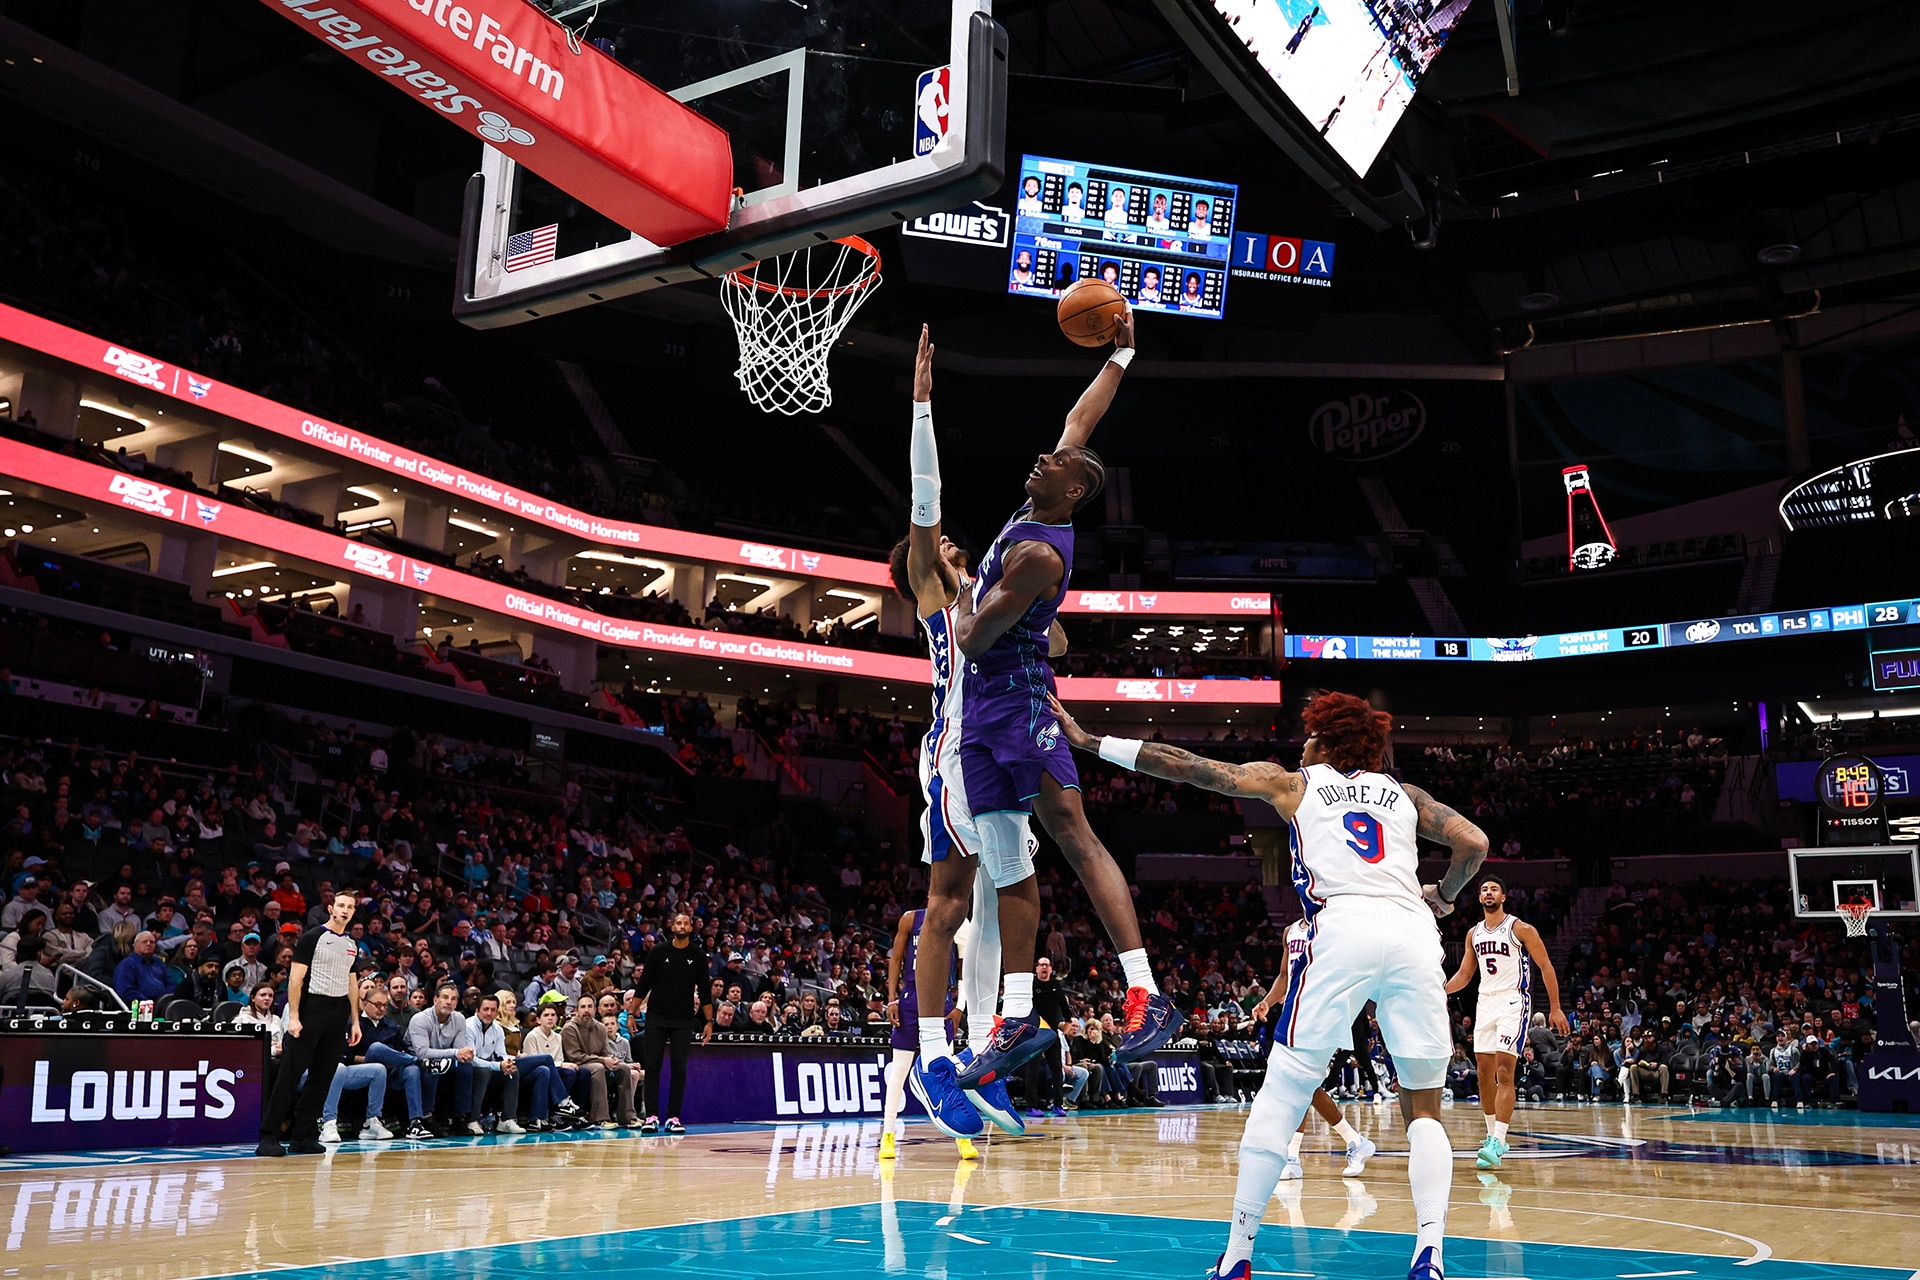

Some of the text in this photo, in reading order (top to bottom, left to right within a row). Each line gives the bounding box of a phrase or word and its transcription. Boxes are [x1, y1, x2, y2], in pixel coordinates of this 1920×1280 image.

[919, 135, 937, 153] NBA
[74, 150, 101, 171] 210
[914, 212, 999, 241] LOWE'S
[1231, 269, 1332, 288] INSURANCE OFFICE OF AMERICA
[103, 346, 165, 381] DEX
[1350, 393, 1390, 425] Dr
[1321, 400, 1418, 454] Pepper
[108, 474, 174, 507] DEX
[301, 420, 641, 543] Official Printer and Copier Provider for your Charlotte Hornets
[343, 543, 394, 570] DEX
[739, 543, 784, 564] DEX
[1260, 558, 1288, 569] HIVE
[1230, 596, 1271, 610] Official
[1733, 623, 1760, 634] TOL
[1762, 619, 1774, 632] 6
[1783, 617, 1807, 630] FLS
[1812, 614, 1823, 627] 2
[1832, 610, 1864, 626] PHI
[1875, 606, 1899, 622] 28
[505, 593, 854, 668] Official Printer and Copier Provider for your Charlotte Hornets
[1559, 631, 1608, 645] POINTS IN
[1631, 631, 1650, 645] 20
[1373, 637, 1420, 648] POINTS IN
[1443, 643, 1458, 656] 18
[1559, 642, 1610, 655] THE PAINT
[1371, 648, 1421, 659] THE PAINT
[1881, 660, 1920, 680] FLI
[1836, 766, 1869, 782] 8:49
[1373, 787, 1399, 812] JR.
[1844, 782, 1869, 807] 16
[1841, 817, 1879, 826] TISSOT
[1342, 810, 1386, 864] 9
[1474, 941, 1510, 958] PHILA
[1485, 957, 1498, 975] 5
[9, 1019, 262, 1032] G G G G G G G G G G G G
[1500, 1034, 1512, 1046] 76
[1157, 1063, 1197, 1092] OWE'S
[30, 1060, 236, 1123] LOWE'S
